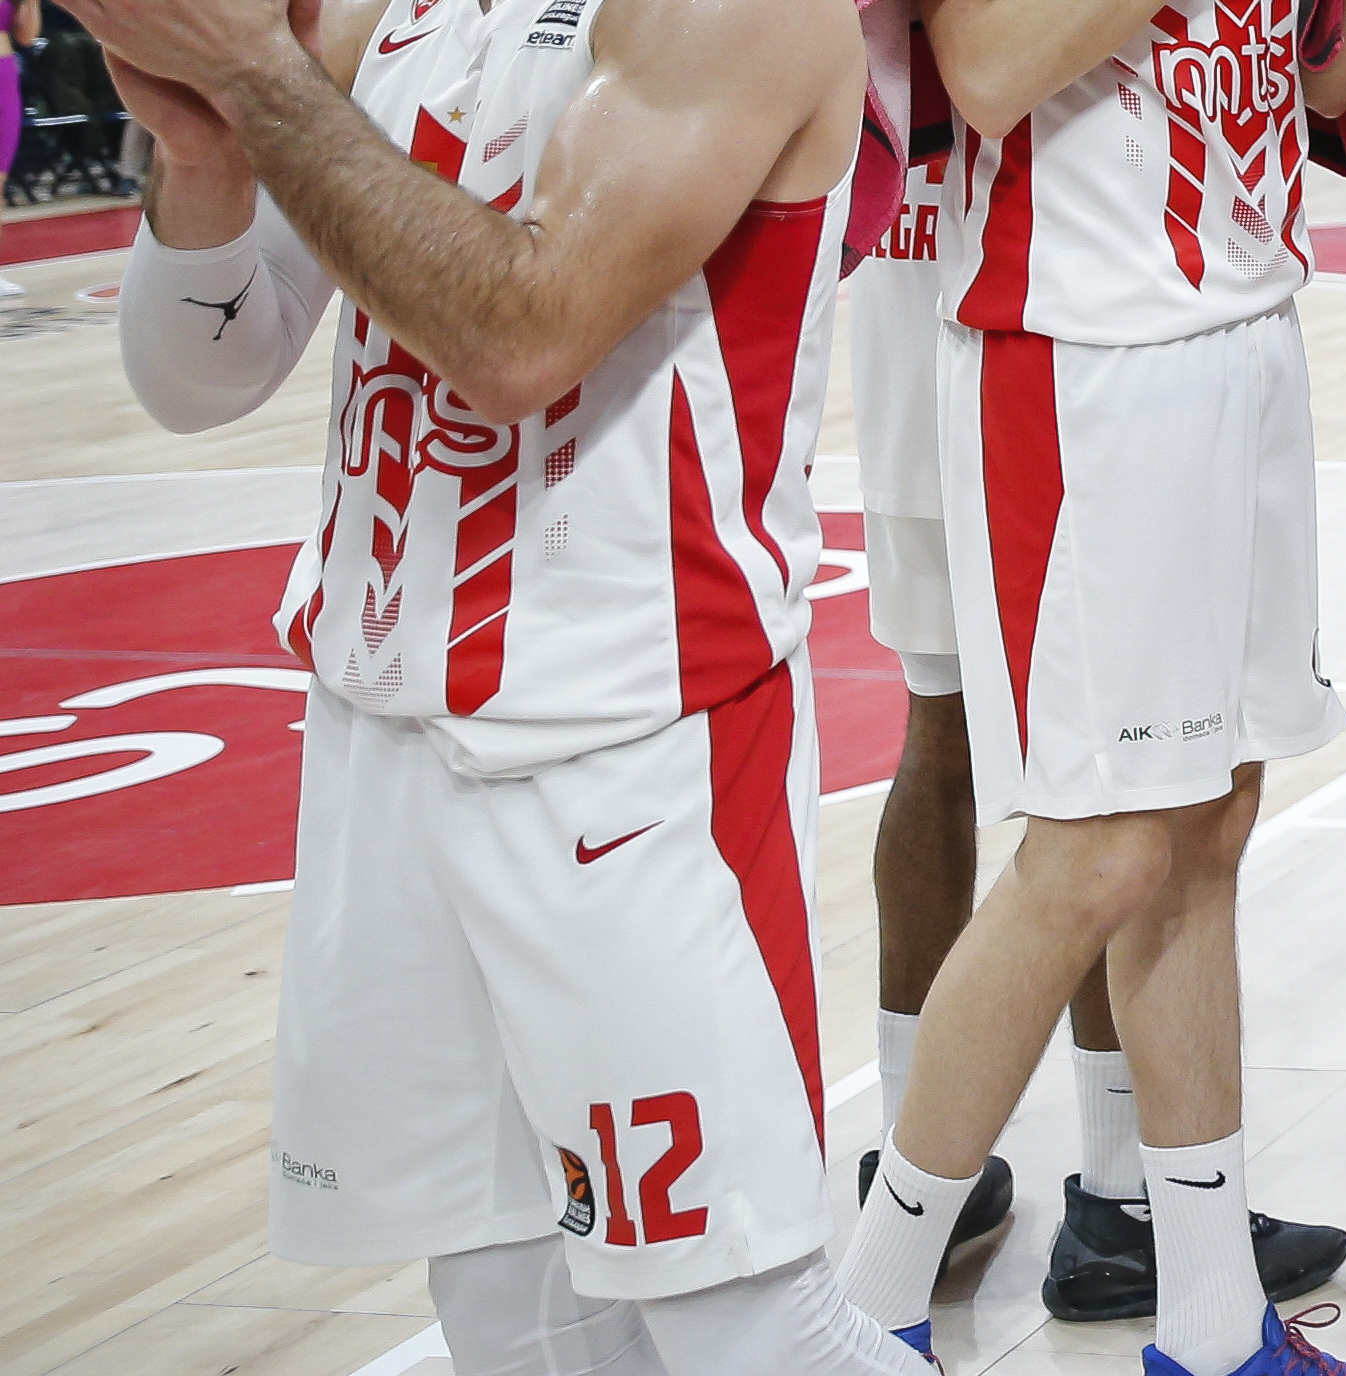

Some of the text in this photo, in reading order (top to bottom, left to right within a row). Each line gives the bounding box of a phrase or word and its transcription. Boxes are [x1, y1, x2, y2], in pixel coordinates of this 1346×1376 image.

[1160, 25, 1291, 122] mts
[1119, 725, 1153, 742] AIK
[1182, 713, 1223, 735] Banka
[282, 1151, 337, 1182] Banka
[590, 1090, 709, 1246] 12
